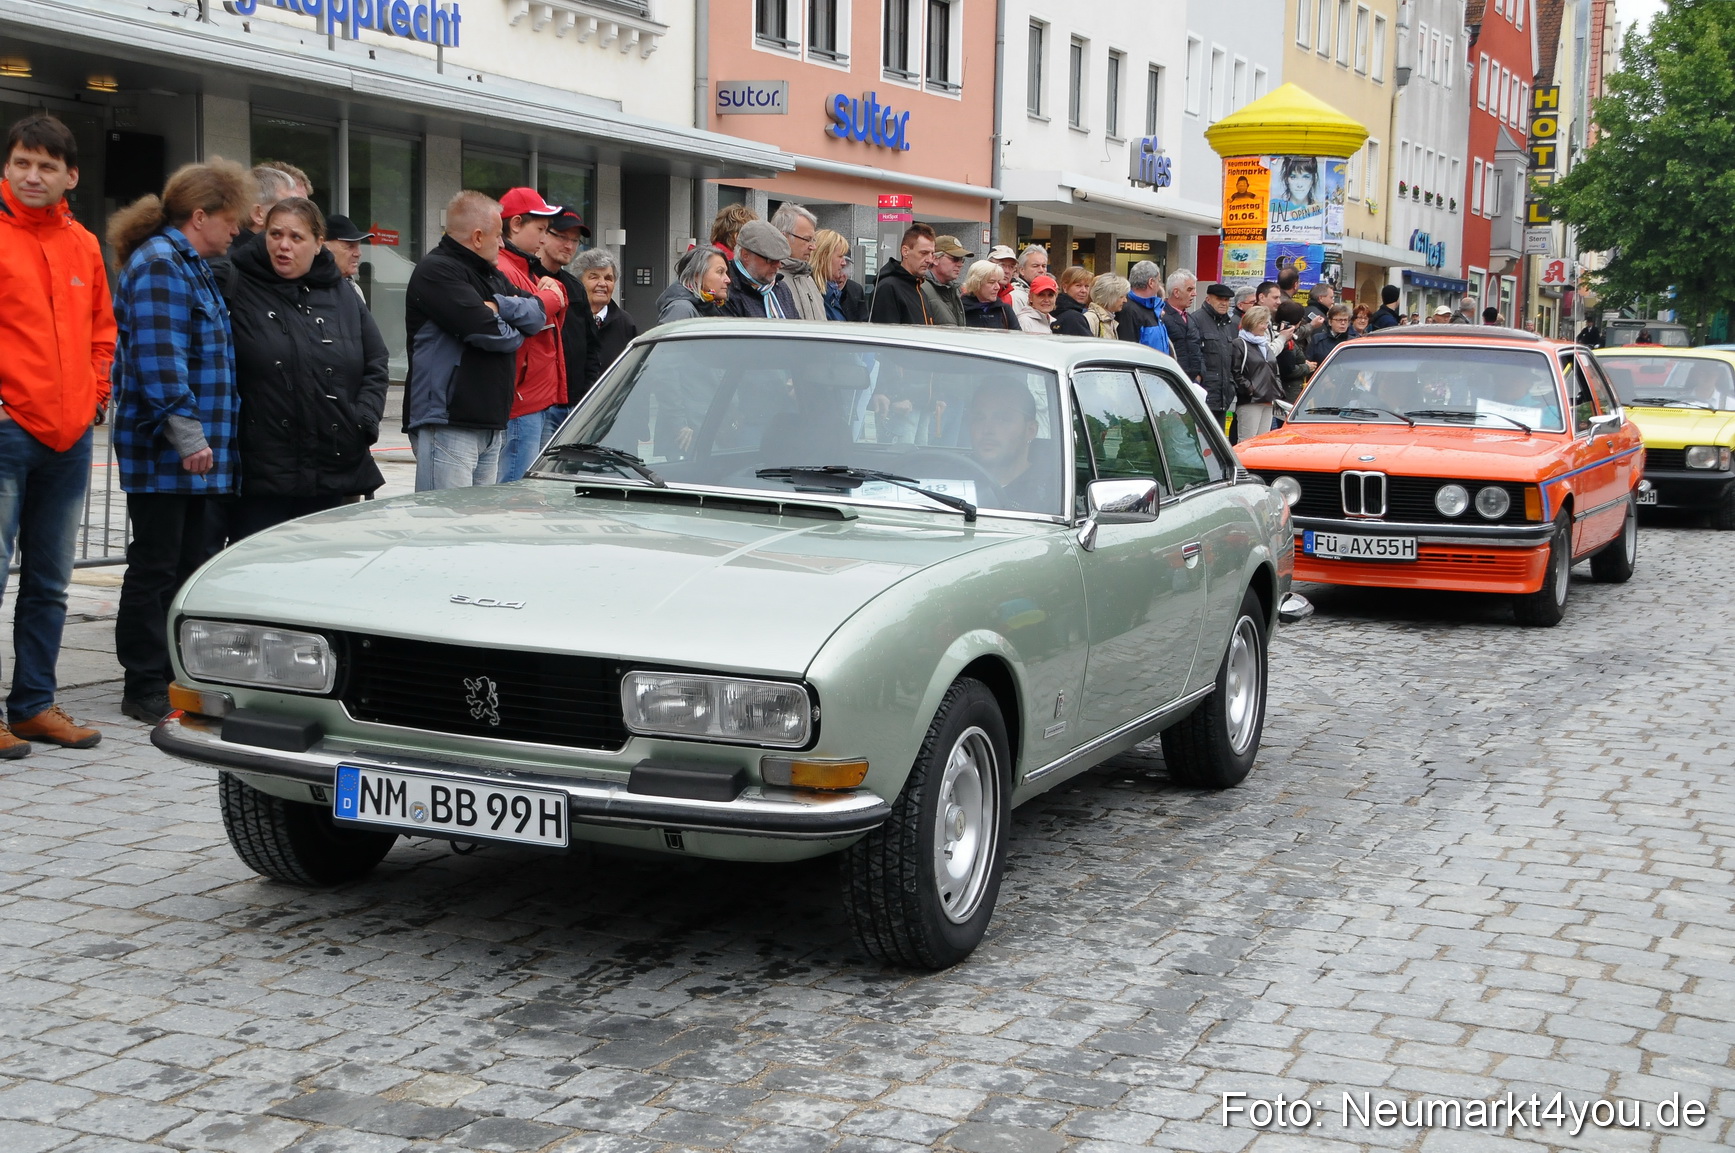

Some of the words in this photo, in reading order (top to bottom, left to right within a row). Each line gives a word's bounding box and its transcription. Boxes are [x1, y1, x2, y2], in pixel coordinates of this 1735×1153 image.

[275, 0, 462, 48] pprecht
[718, 86, 781, 108] sutor.
[833, 91, 910, 151] sutor.
[1139, 136, 1172, 188] fries
[1228, 203, 1260, 211] Samstag
[1228, 212, 1259, 221] 01.06.
[1271, 200, 1290, 224] ZAZ
[1291, 207, 1311, 221] OPEN
[1312, 204, 1322, 216] AIR
[1270, 224, 1293, 233] 25.6.
[1118, 242, 1150, 251] FRIES
[1314, 533, 1338, 553] FÜ
[343, 797, 352, 810] D
[359, 775, 407, 818] NM
[430, 784, 478, 827] BB
